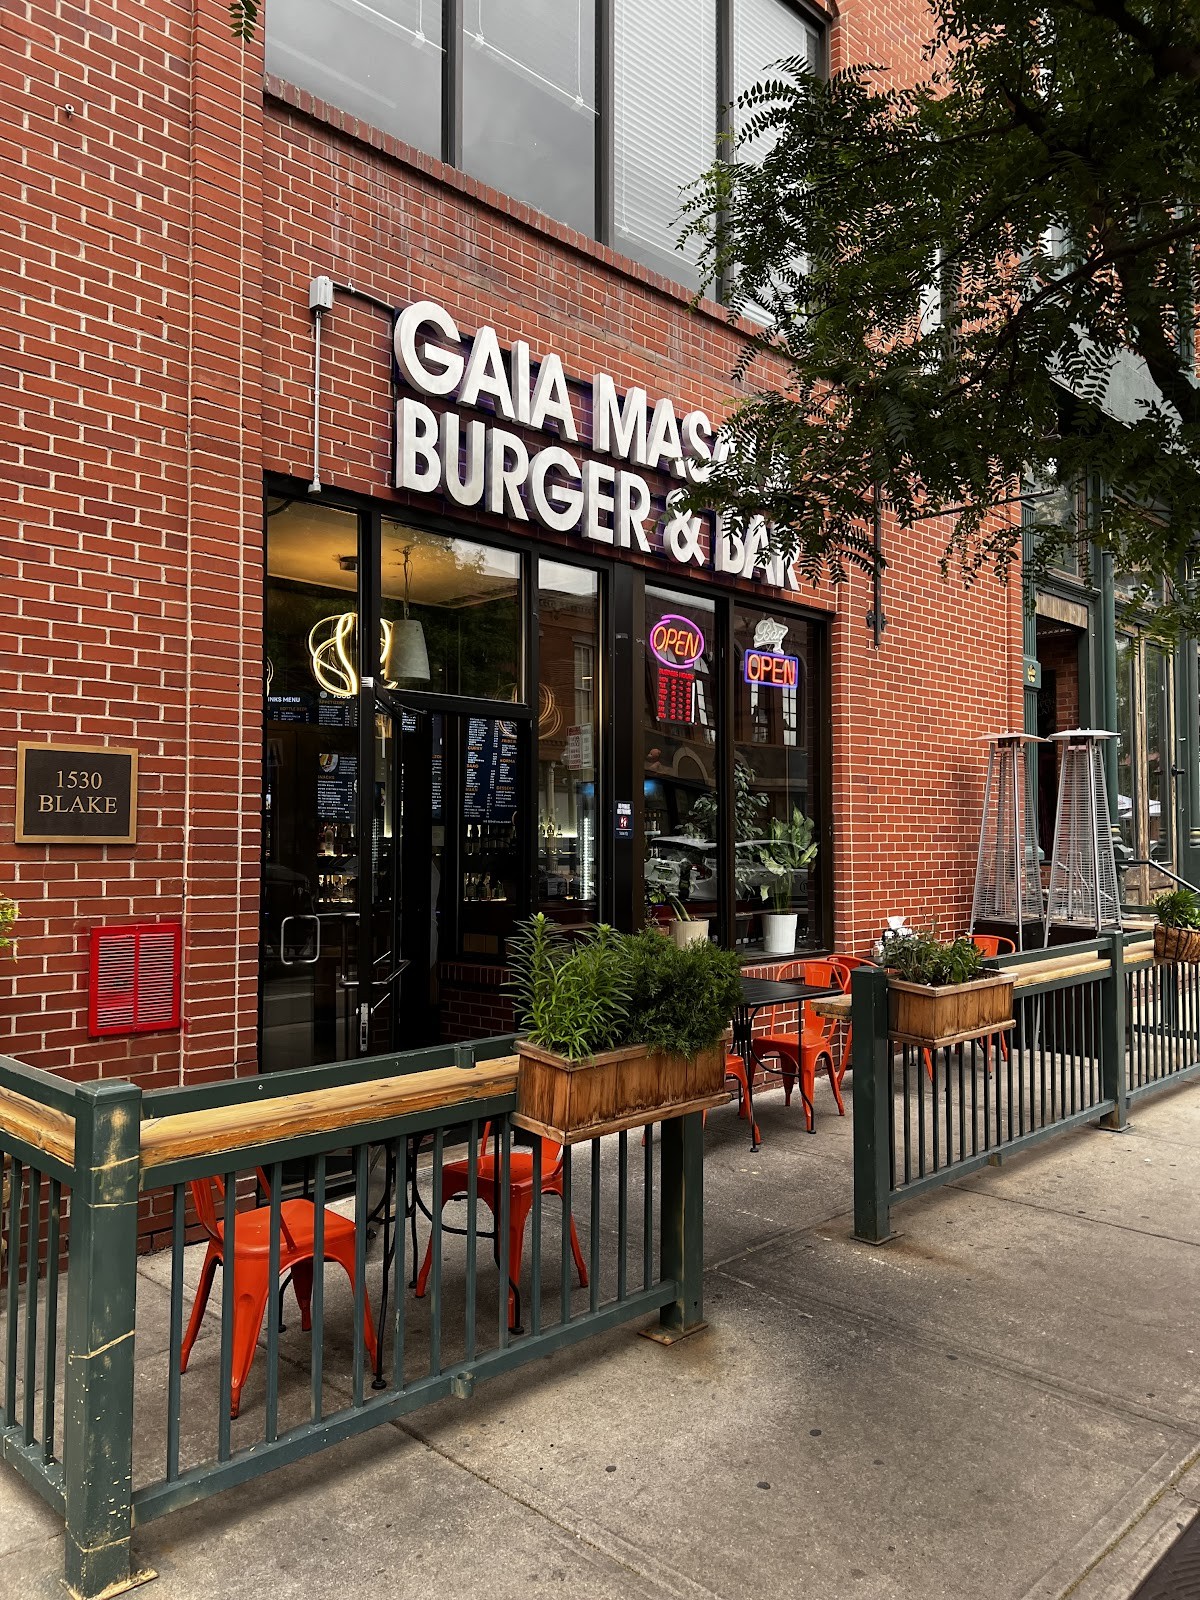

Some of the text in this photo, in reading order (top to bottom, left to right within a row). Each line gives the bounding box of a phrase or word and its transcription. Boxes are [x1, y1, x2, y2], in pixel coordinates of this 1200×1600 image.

[394, 300, 794, 498] GAIA MAS
[396, 397, 801, 591] BURGER & BAR
[653, 626, 700, 658] OPEN
[755, 618, 787, 643] Bar
[748, 653, 796, 686] OPEN
[56, 770, 103, 790] 1530
[38, 794, 118, 814] BLAKE
